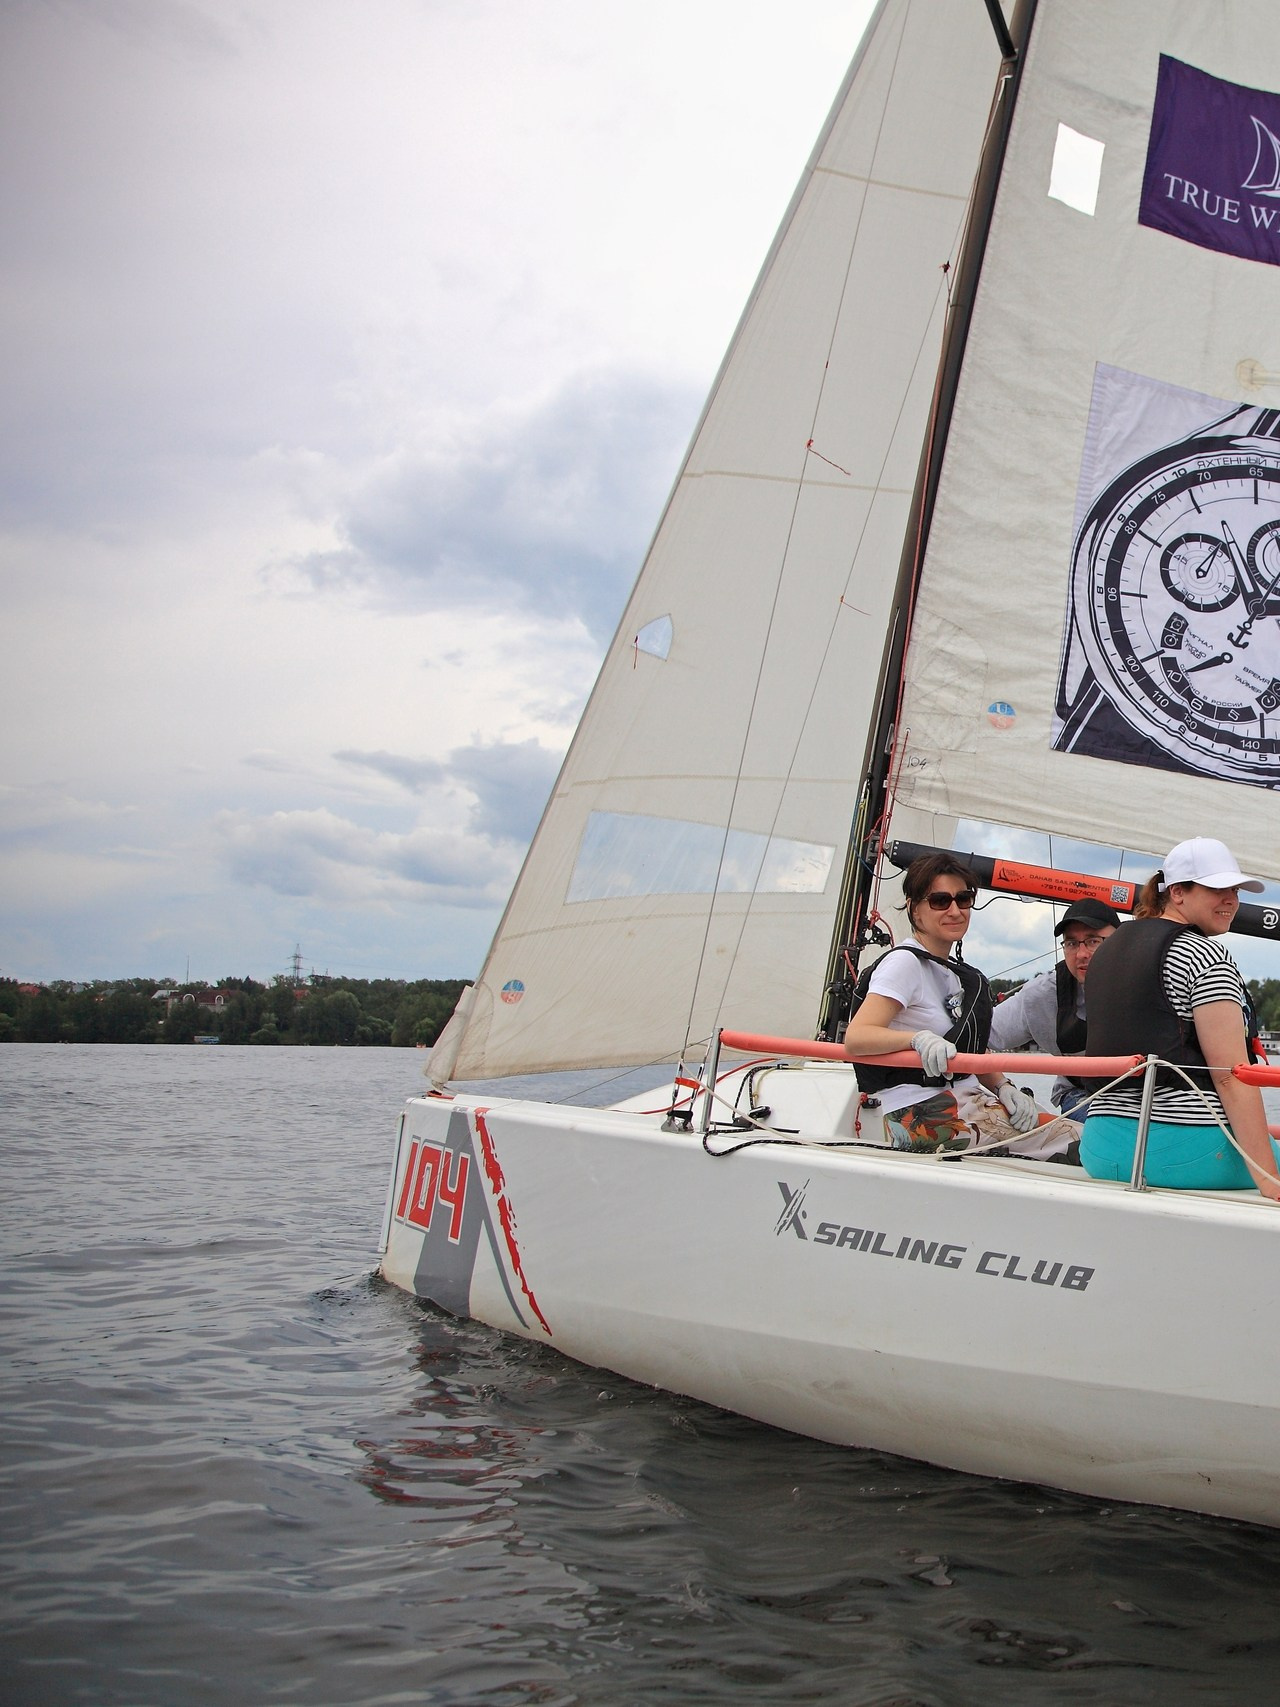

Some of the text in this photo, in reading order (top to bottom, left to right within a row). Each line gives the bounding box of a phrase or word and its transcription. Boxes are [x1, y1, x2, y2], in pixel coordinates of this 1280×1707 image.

[1163, 173, 1241, 224] TRUE
[1197, 456, 1267, 469] ЯХТЕННЫЙ
[1172, 467, 1187, 479] 10
[1197, 471, 1211, 482] 70
[1249, 467, 1264, 477] 65
[1151, 491, 1166, 505] 75
[1117, 513, 1126, 523] 9
[1124, 519, 1138, 535] 80
[1173, 553, 1188, 565] 45
[1107, 587, 1117, 601] 90
[1181, 588, 1195, 601] 30
[1217, 582, 1230, 593] 15
[1117, 664, 1127, 674] 7
[1125, 654, 1140, 673] 100
[1166, 669, 1183, 683] 10
[1242, 666, 1271, 685] ВРЕМЯ
[1234, 674, 1262, 694] ТАЙМЕР
[1152, 690, 1170, 708] 110
[1190, 698, 1204, 711] 6
[1183, 713, 1198, 729] 120
[1240, 740, 1260, 750] 140
[907, 755, 927, 770] 104
[1258, 754, 1268, 762] 5
[1029, 874, 1110, 892] DAHAB SAILIN ENTER
[395, 1135, 471, 1245] 104
[813, 1221, 968, 1270] SAILING
[975, 1251, 1096, 1292] CLUB
